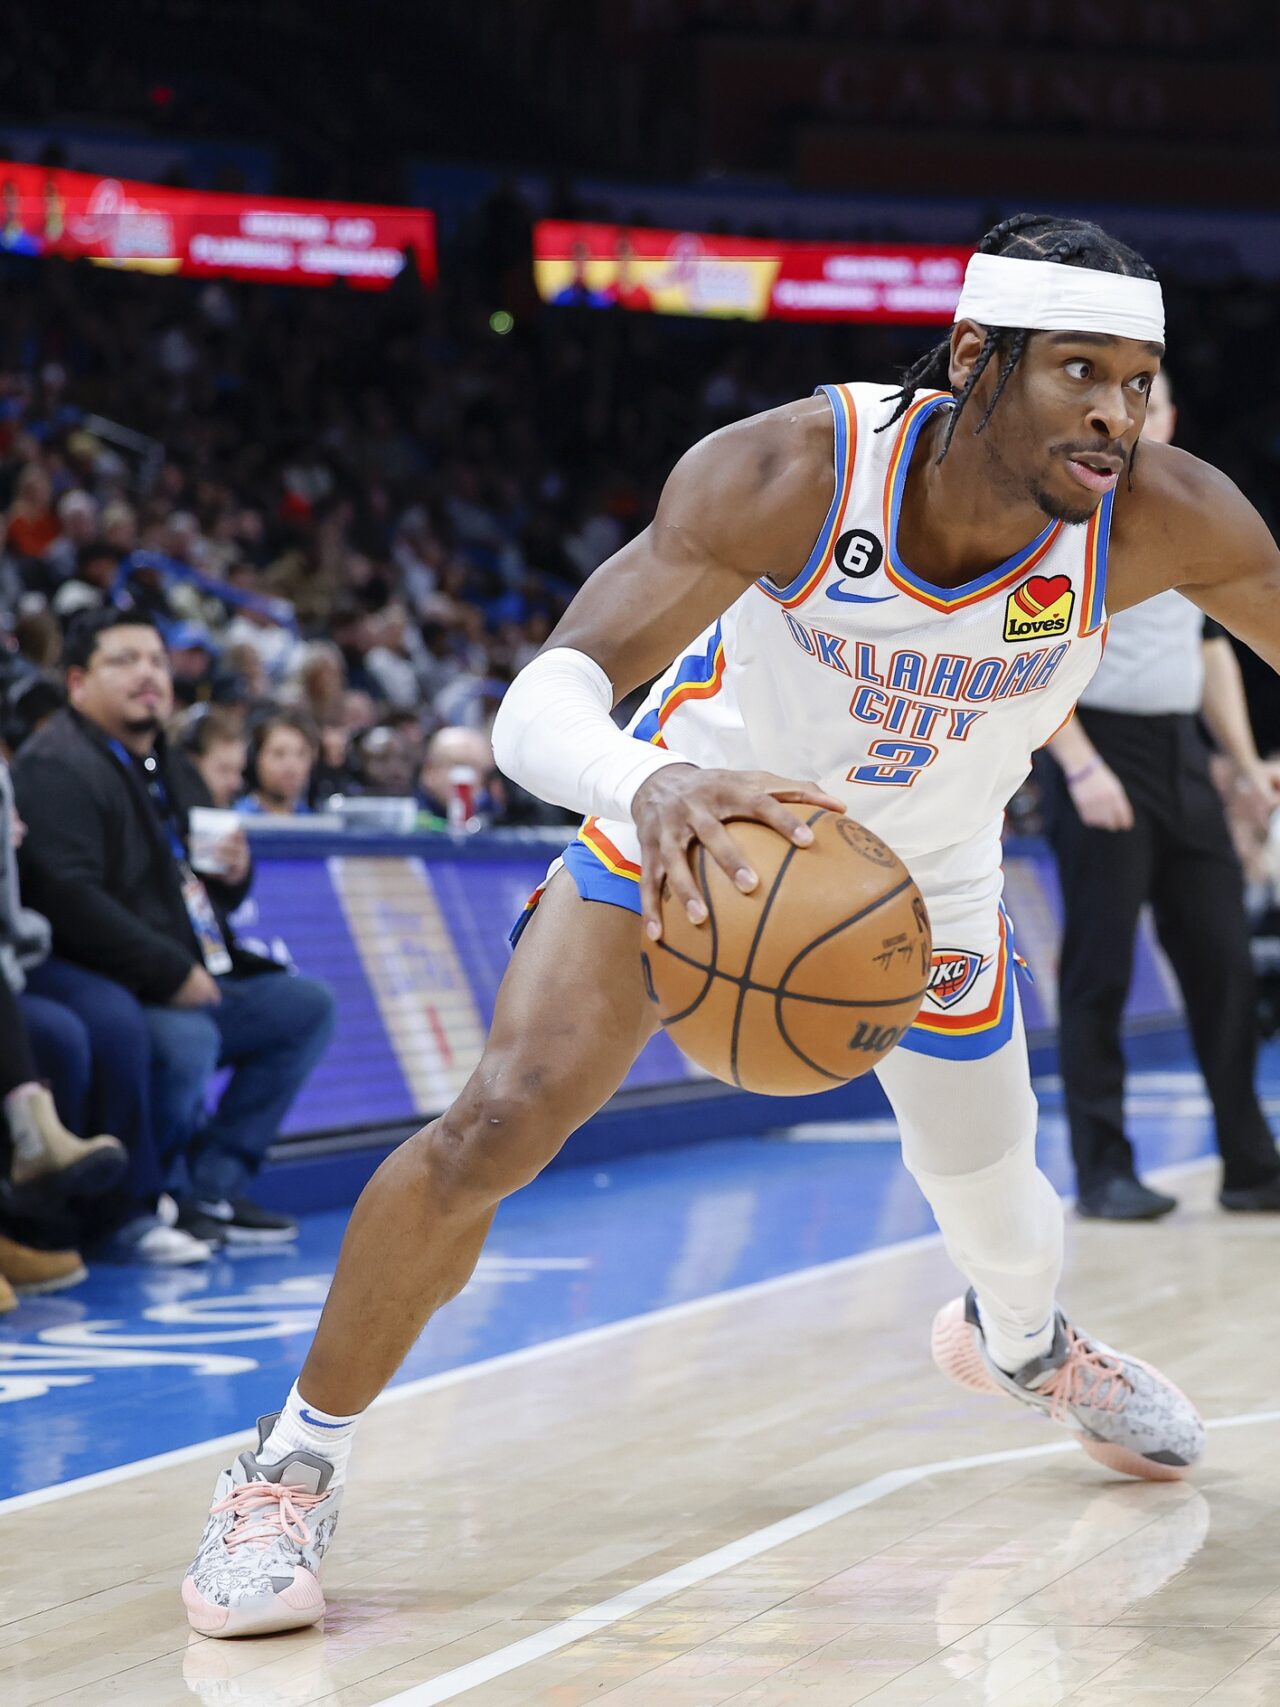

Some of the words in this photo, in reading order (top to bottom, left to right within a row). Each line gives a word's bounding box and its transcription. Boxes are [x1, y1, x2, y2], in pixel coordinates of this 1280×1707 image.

[842, 535, 874, 573] 6
[782, 609, 1071, 703] OKLAHOMA
[849, 685, 988, 742] CITY
[846, 739, 939, 787] 2
